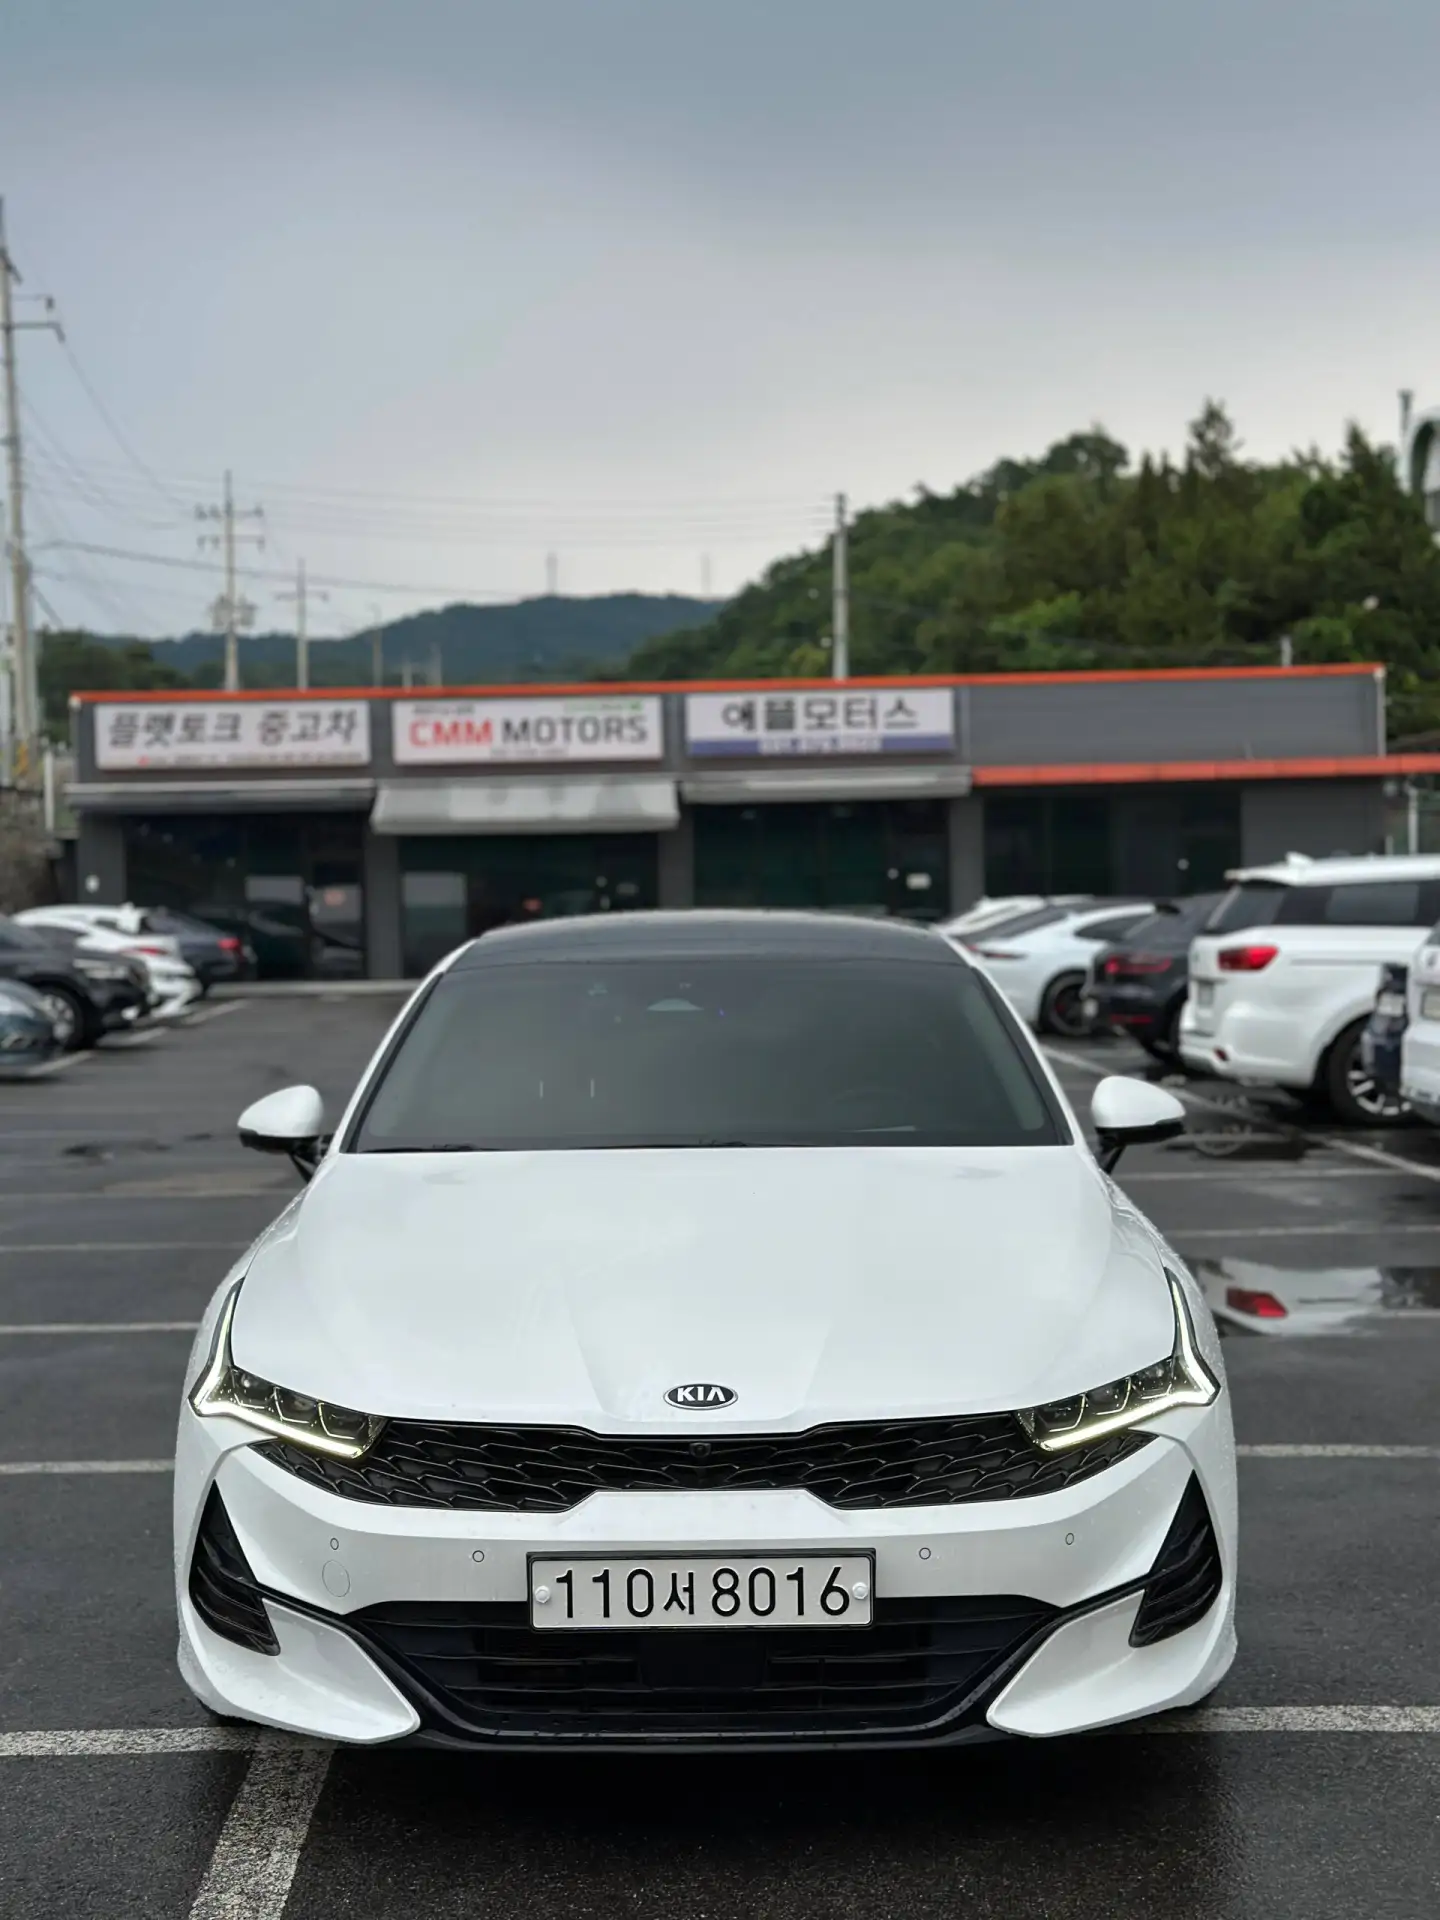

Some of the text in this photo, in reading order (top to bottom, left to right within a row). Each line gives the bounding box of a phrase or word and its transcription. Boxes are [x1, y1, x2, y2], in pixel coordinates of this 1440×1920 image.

[257, 708, 357, 746] 중고차
[409, 715, 648, 746] CMM MOTORS
[677, 1386, 726, 1402] KIA
[556, 1566, 850, 1618] 110서8016
